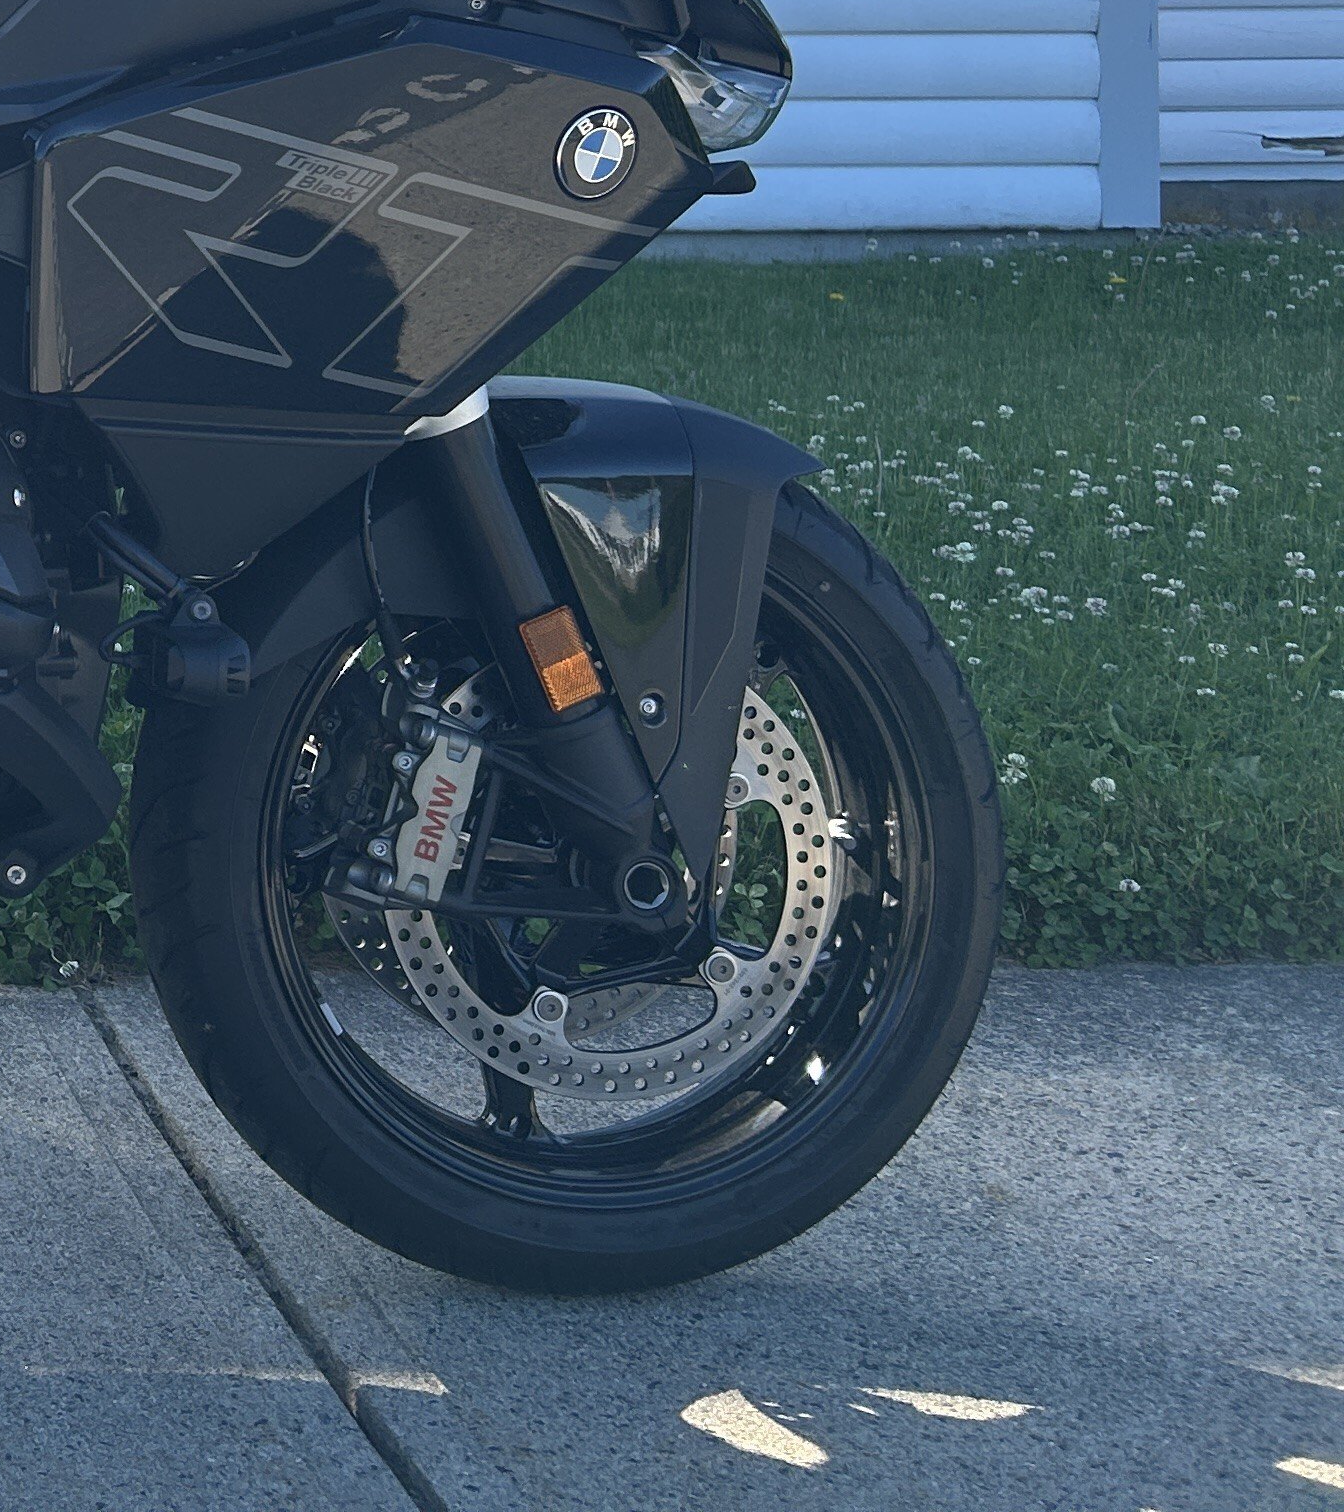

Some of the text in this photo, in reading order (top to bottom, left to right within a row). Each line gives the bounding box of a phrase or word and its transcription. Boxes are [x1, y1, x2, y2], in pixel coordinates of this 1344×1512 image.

[576, 112, 636, 148] BMW
[287, 153, 348, 180] Triple
[295, 175, 357, 201] Black
[414, 775, 457, 863] BMW
